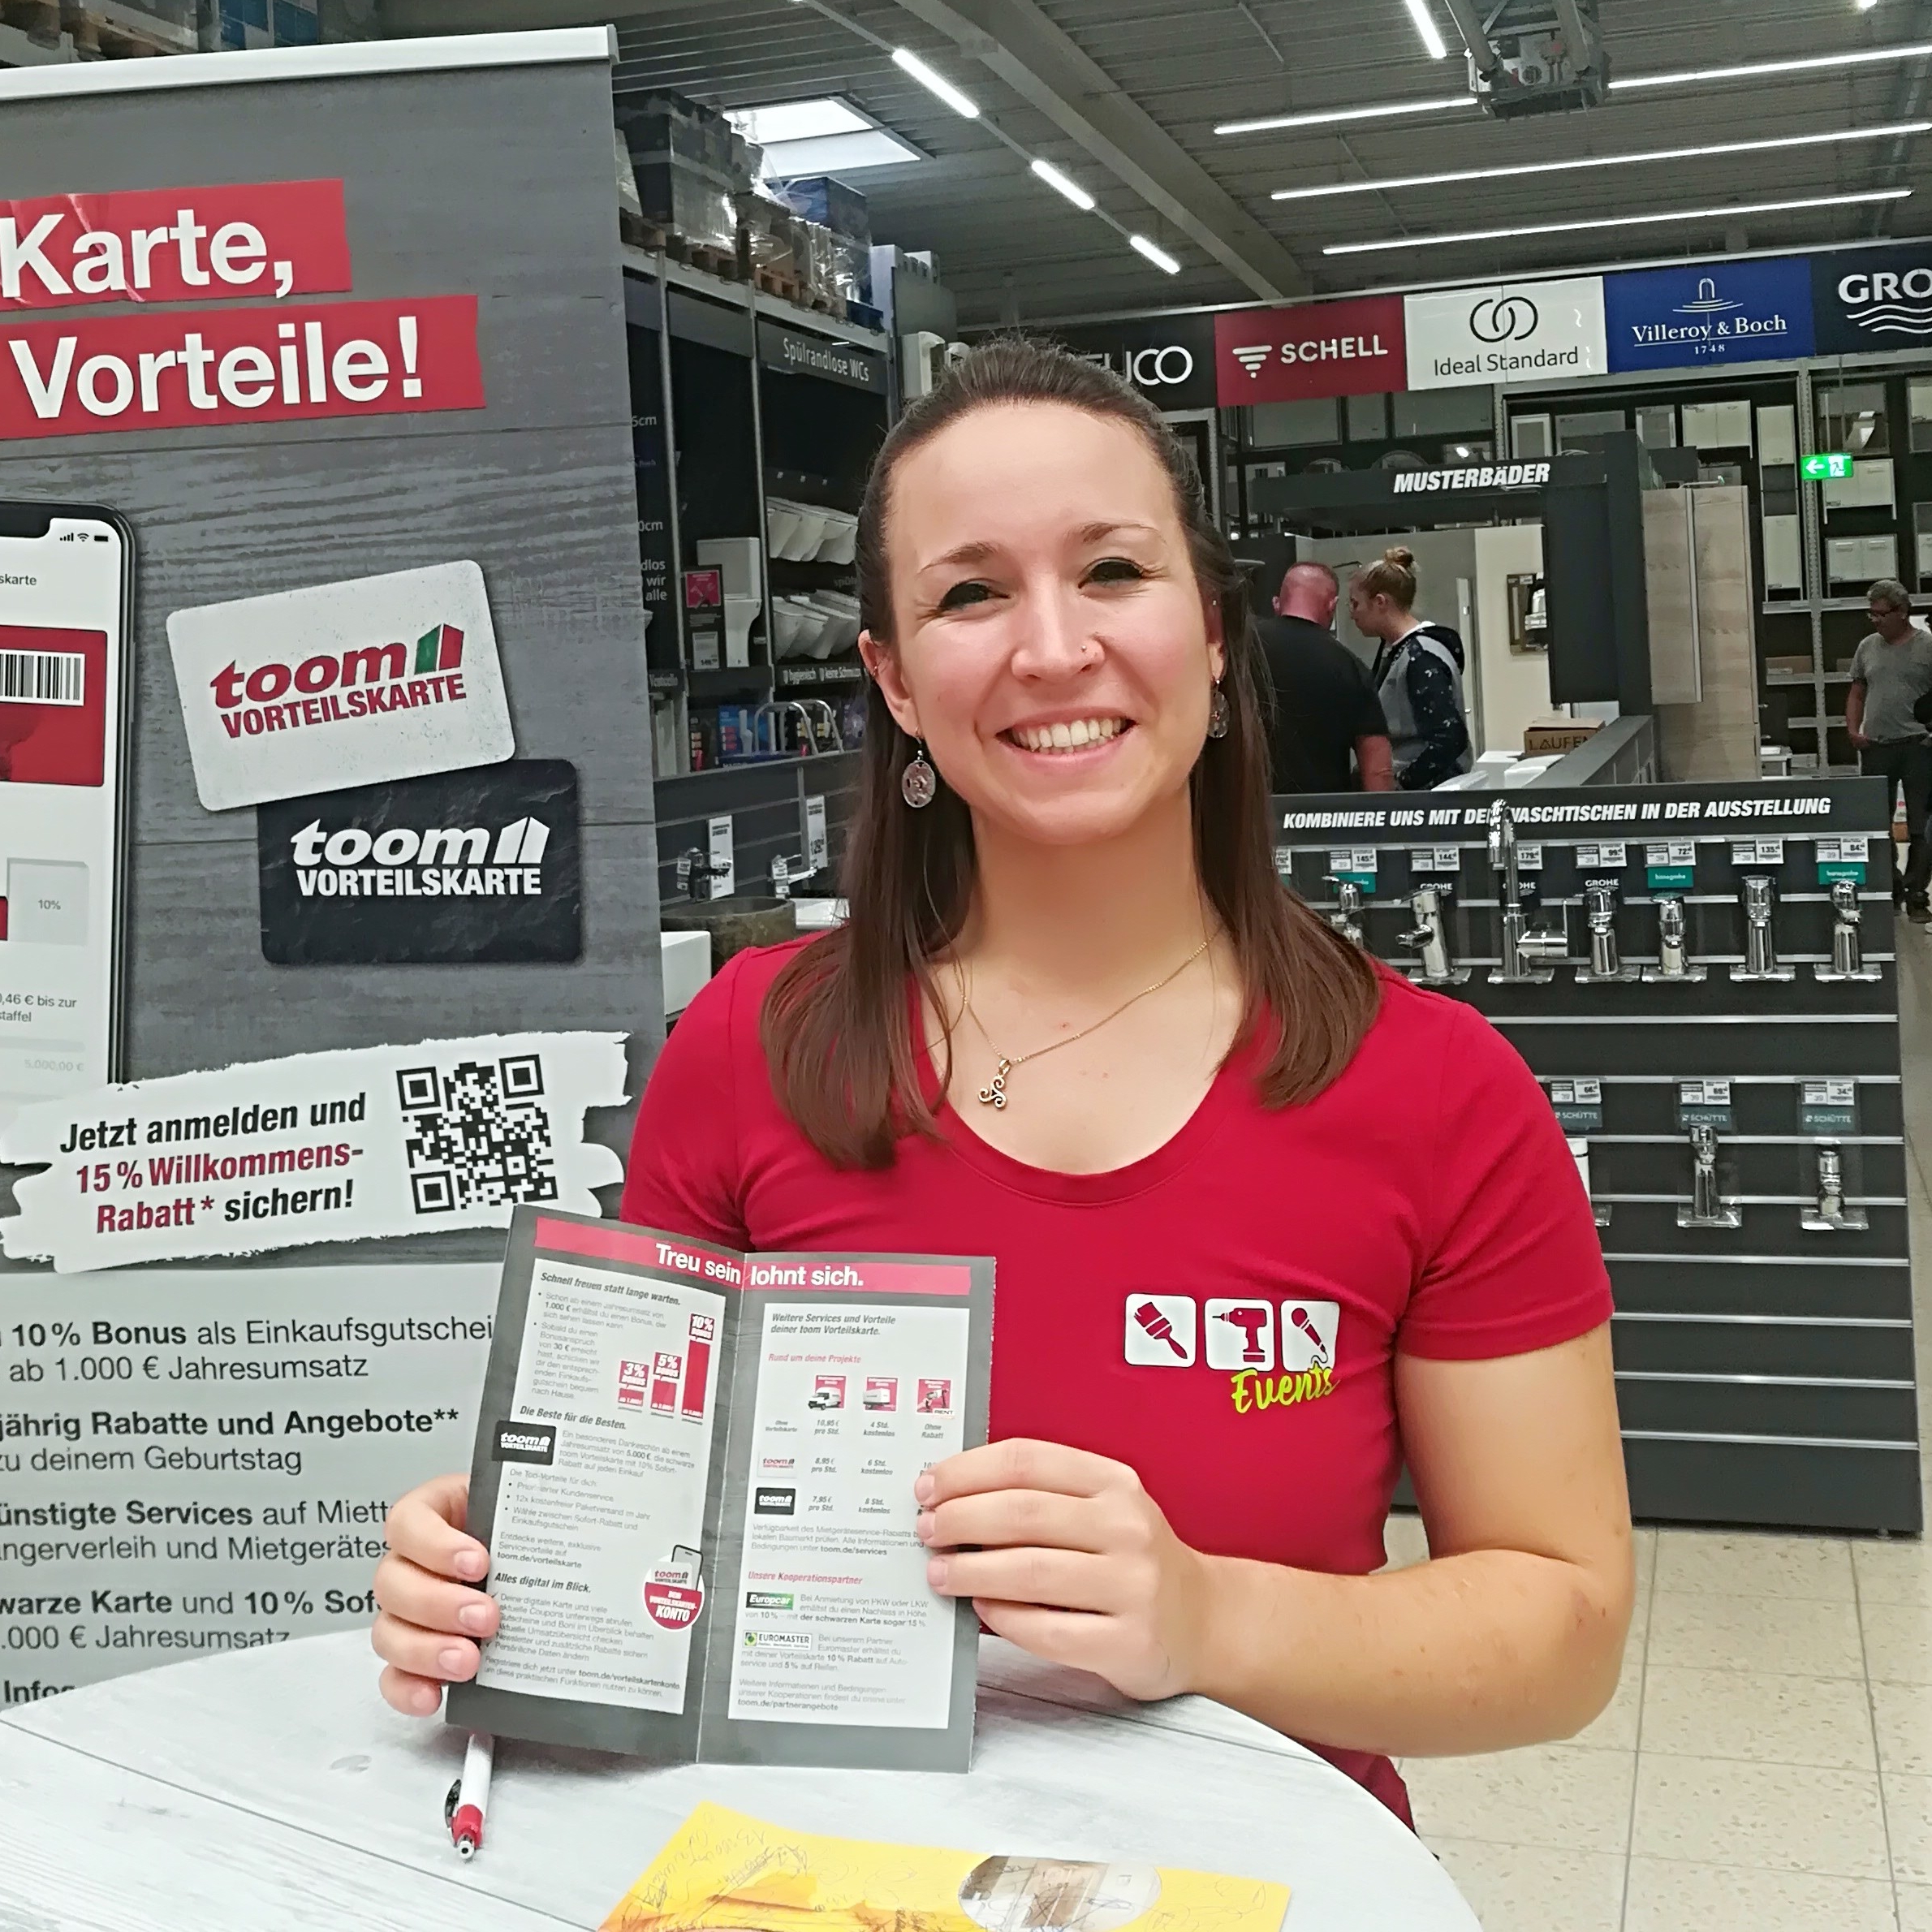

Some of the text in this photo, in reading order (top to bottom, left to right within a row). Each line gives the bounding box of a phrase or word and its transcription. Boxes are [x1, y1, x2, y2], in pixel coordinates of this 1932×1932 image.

[0, 209, 293, 299] Karte,
[1632, 315, 1787, 343] Villeroy & Boch
[783, 338, 869, 382] Spülrandlose WCs
[1281, 334, 1388, 364] SCHELL
[1434, 347, 1578, 376] Ideal Standard
[1695, 344, 1725, 355] 1748
[9, 315, 422, 419] Vorteile!
[1393, 463, 1550, 493] MUSTERBÄDER
[646, 575, 666, 587] wir
[210, 642, 407, 709] toom
[221, 674, 466, 739] VORTEILSKARTE
[1283, 811, 1386, 829] KOMBINIERE
[1390, 810, 1424, 826] UNS
[1429, 809, 1461, 825] MIT
[1641, 803, 1660, 820] IN
[1665, 801, 1701, 819] DER
[1705, 797, 1831, 817] AUSSTELLUNG
[291, 819, 490, 865] toom
[297, 869, 541, 896] VORTEILSKARTE
[39, 900, 61, 910] 10%
[24, 995, 33, 1005] €
[38, 996, 54, 1007] bis
[58, 998, 76, 1007] zur
[60, 1092, 365, 1153] Jetzt anmelden und
[149, 1143, 363, 1186] Willkommens-
[225, 1179, 353, 1221] sichern!
[656, 1244, 864, 1286] Treu sein lohnt sich.
[541, 1272, 680, 1305] Schnell freuen statt lange warten.
[92, 1322, 187, 1344] Bonus
[198, 1321, 236, 1344] als
[247, 1315, 492, 1347] Einkaufsgutschei
[771, 1326, 881, 1335] deiner toom Vorteilskarte.
[773, 1313, 895, 1325] Weitere Services und Vorteile
[10, 1355, 369, 1382] ab 1.000 € Jahresumsatz
[624, 1363, 645, 1378] 3%
[658, 1355, 678, 1369] 5%
[1231, 1361, 1338, 1414] Events
[91, 1412, 208, 1435] Rabatte
[218, 1412, 274, 1435] und
[520, 1406, 626, 1430] Die Beste für die Besten.
[501, 1433, 538, 1444] toom
[31, 1448, 134, 1471] deinem
[144, 1445, 302, 1475] Geburtstag
[127, 1500, 252, 1525] Services
[263, 1501, 307, 1525] auf
[318, 1500, 394, 1524] Miett
[0, 1536, 156, 1567] ngerverleih
[167, 1537, 218, 1559] und
[494, 1572, 591, 1593] Alles digital im Blick.
[778, 1572, 863, 1584] Kooperationspartner
[91, 1590, 172, 1614] Karte
[183, 1591, 232, 1614] und
[325, 1589, 382, 1614] Sof
[656, 1606, 690, 1621] KONTO
[749, 1595, 791, 1606] Europcar
[70, 1625, 86, 1649] €
[759, 1633, 809, 1644] EUROMASTER
[4, 1680, 75, 1703] Info
